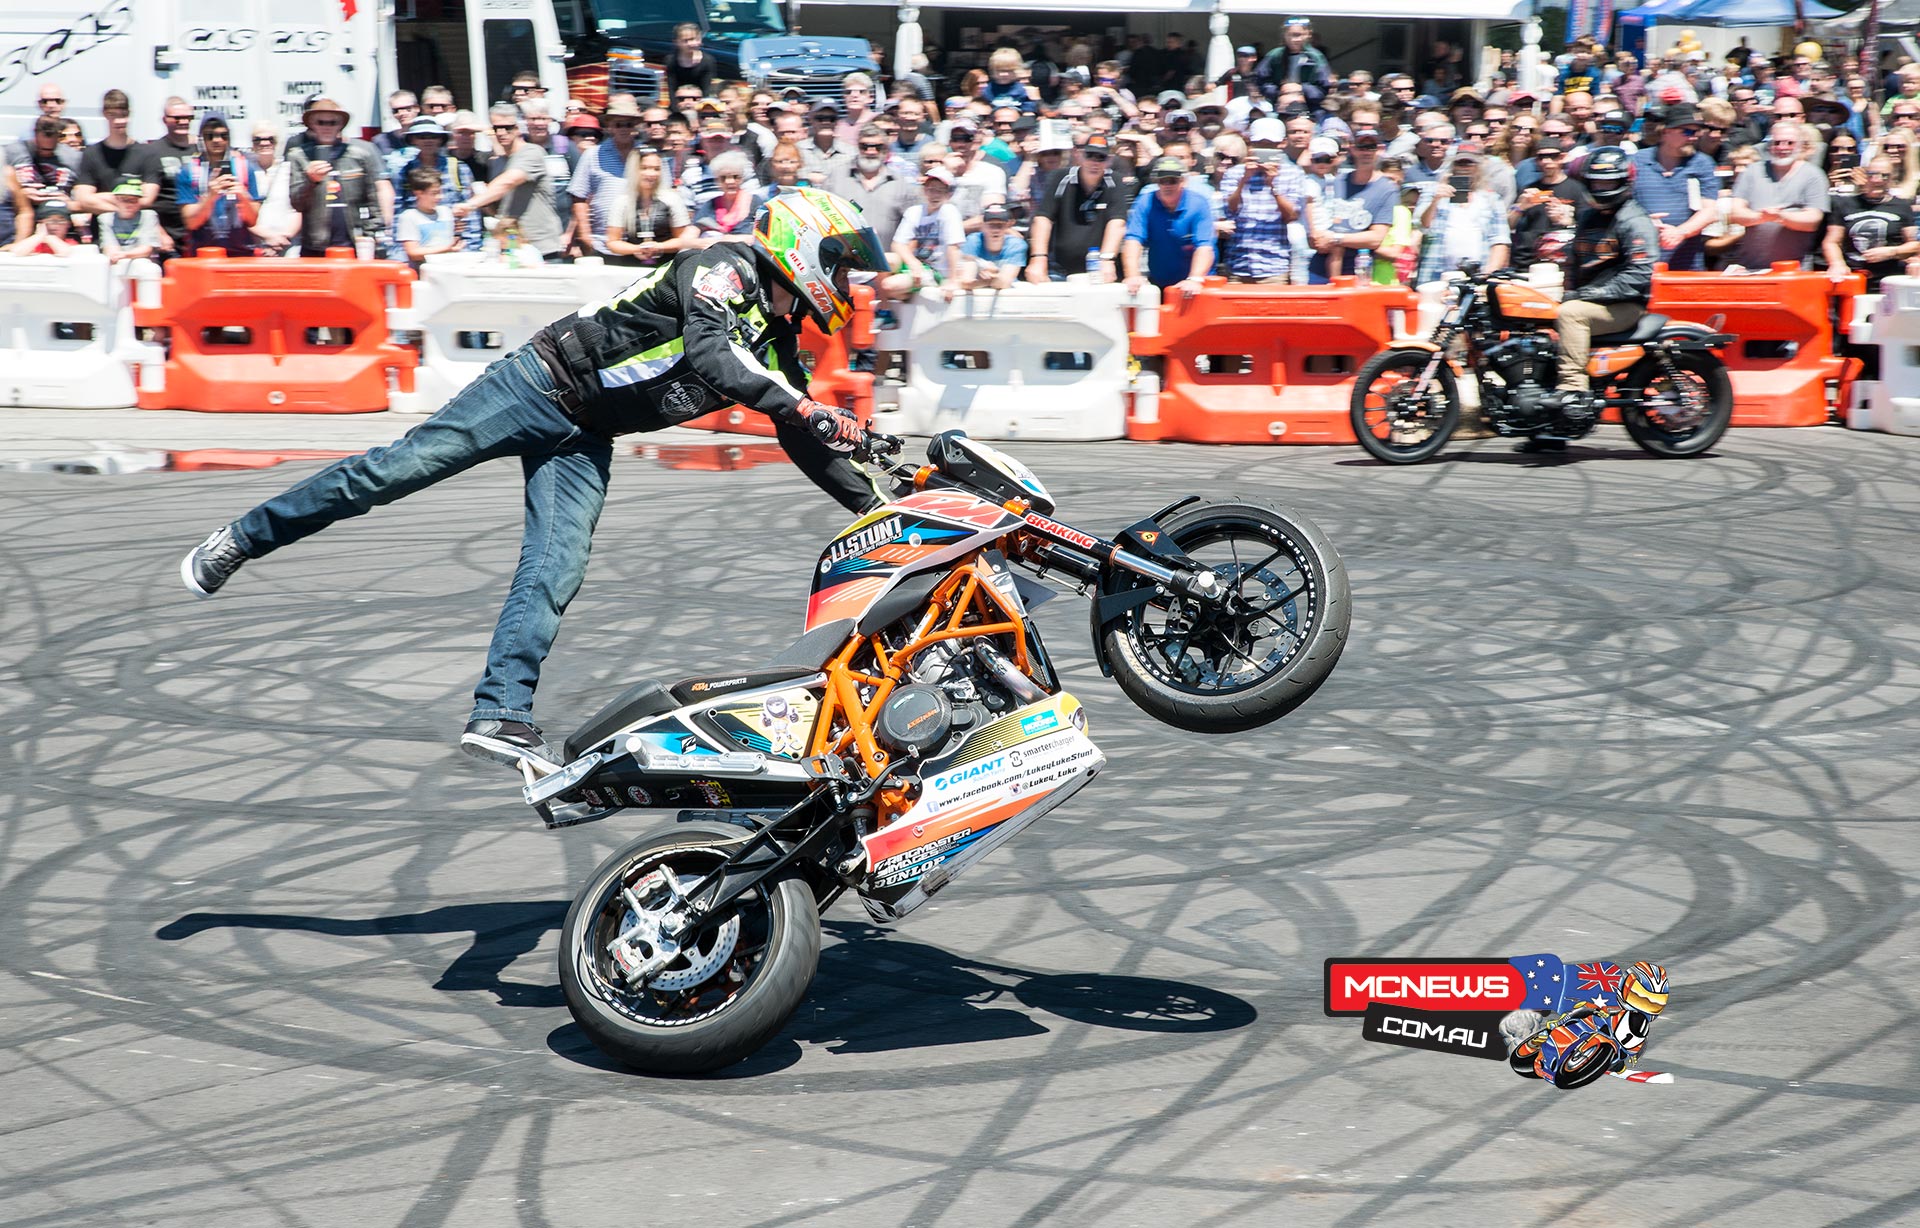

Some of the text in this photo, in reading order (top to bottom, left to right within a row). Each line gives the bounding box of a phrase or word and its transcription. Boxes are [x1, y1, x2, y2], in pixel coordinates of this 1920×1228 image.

[789, 252, 805, 274] BELL
[806, 281, 833, 314] KTM
[1026, 514, 1096, 549] BRAKING
[1023, 735, 1075, 758] smartercharger
[950, 757, 1005, 785] GIANT
